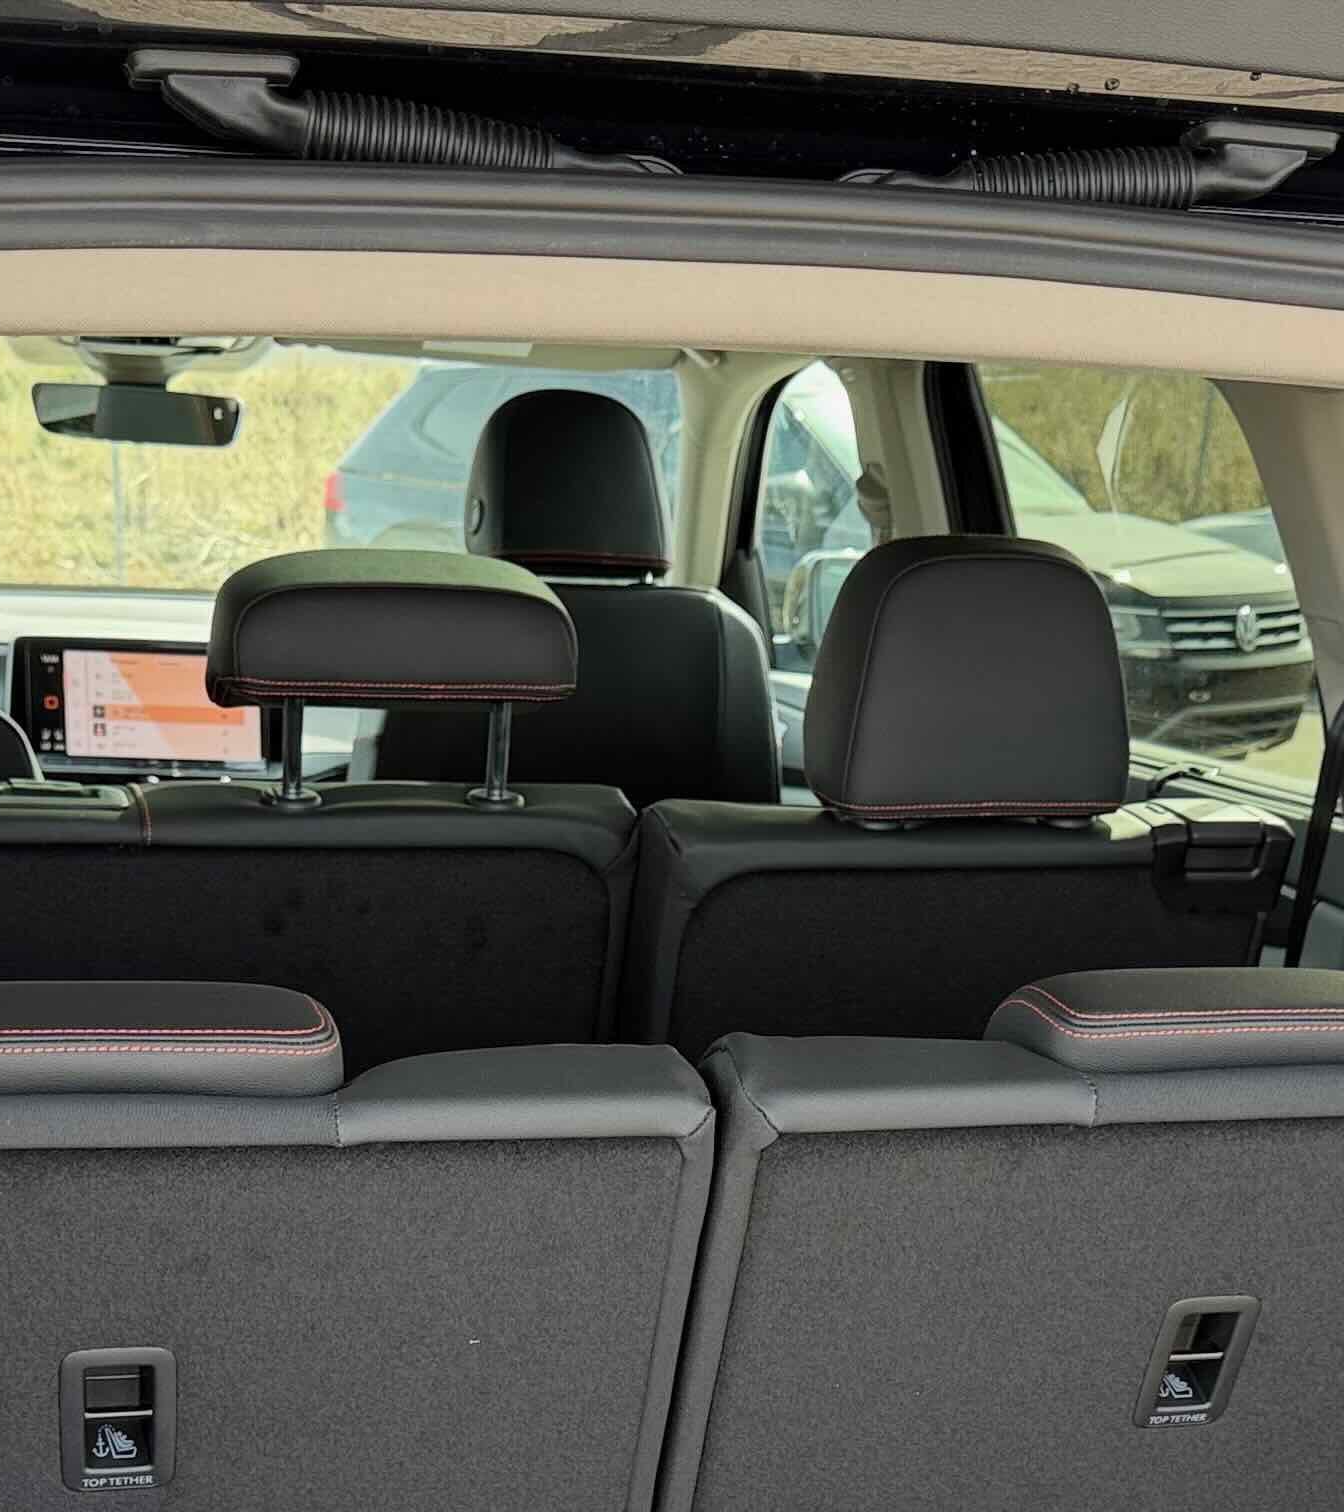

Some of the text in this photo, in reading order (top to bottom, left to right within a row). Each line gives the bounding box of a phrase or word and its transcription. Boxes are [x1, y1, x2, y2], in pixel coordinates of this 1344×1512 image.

[1149, 1413, 1208, 1425] TOP TETHER
[82, 1475, 153, 1488] TOP TETHER
